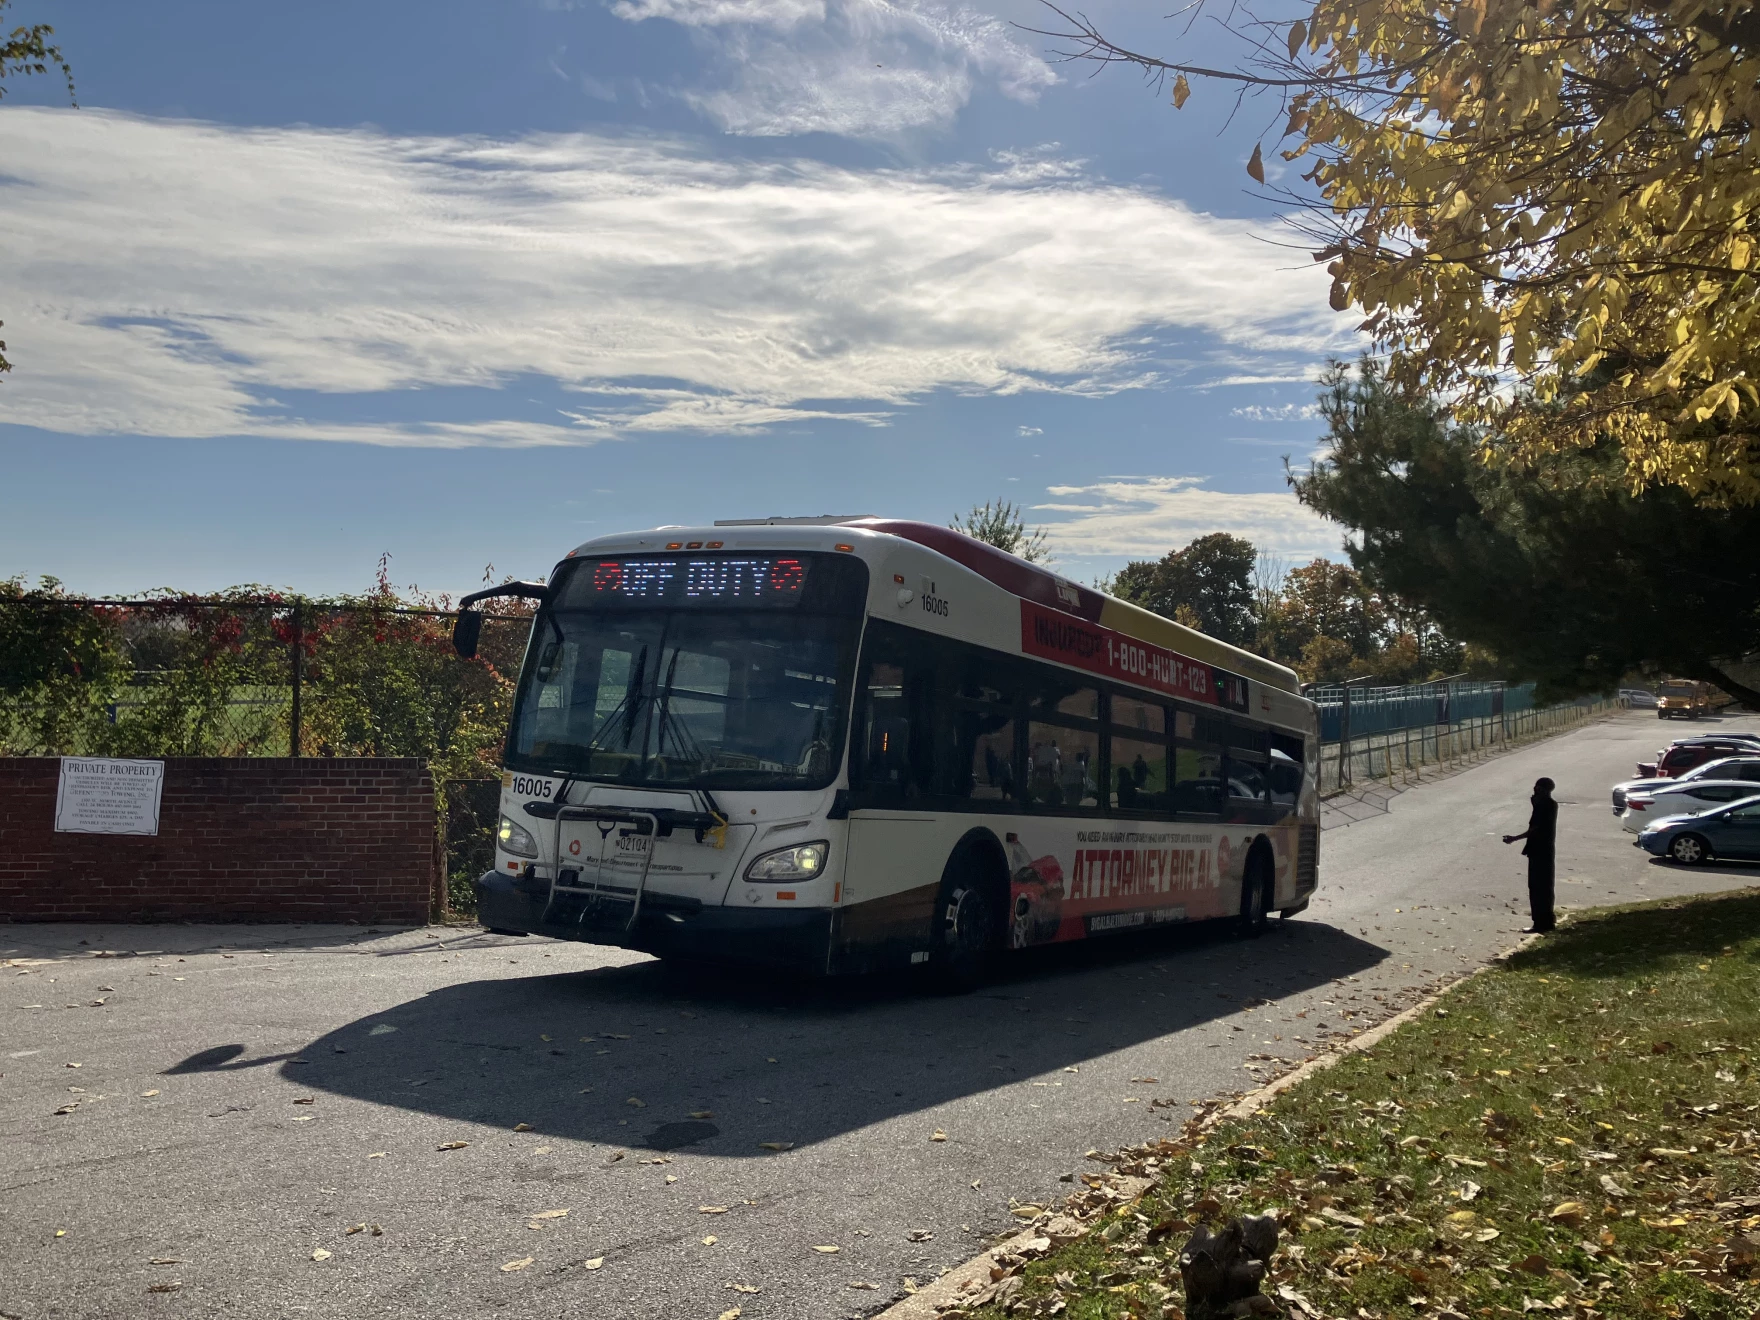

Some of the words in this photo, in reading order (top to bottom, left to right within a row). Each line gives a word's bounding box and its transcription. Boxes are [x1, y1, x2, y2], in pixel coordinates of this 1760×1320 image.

[622, 562, 676, 596] OFF
[687, 561, 770, 596] DUTY
[922, 594, 948, 617] 16005
[68, 762, 106, 773] PRIVATE
[109, 765, 156, 775] PROPERTY
[513, 776, 552, 798] 16005
[586, 856, 609, 864] Maryand
[648, 863, 684, 872] ransportation
[1070, 850, 1168, 899] ATTORNEY
